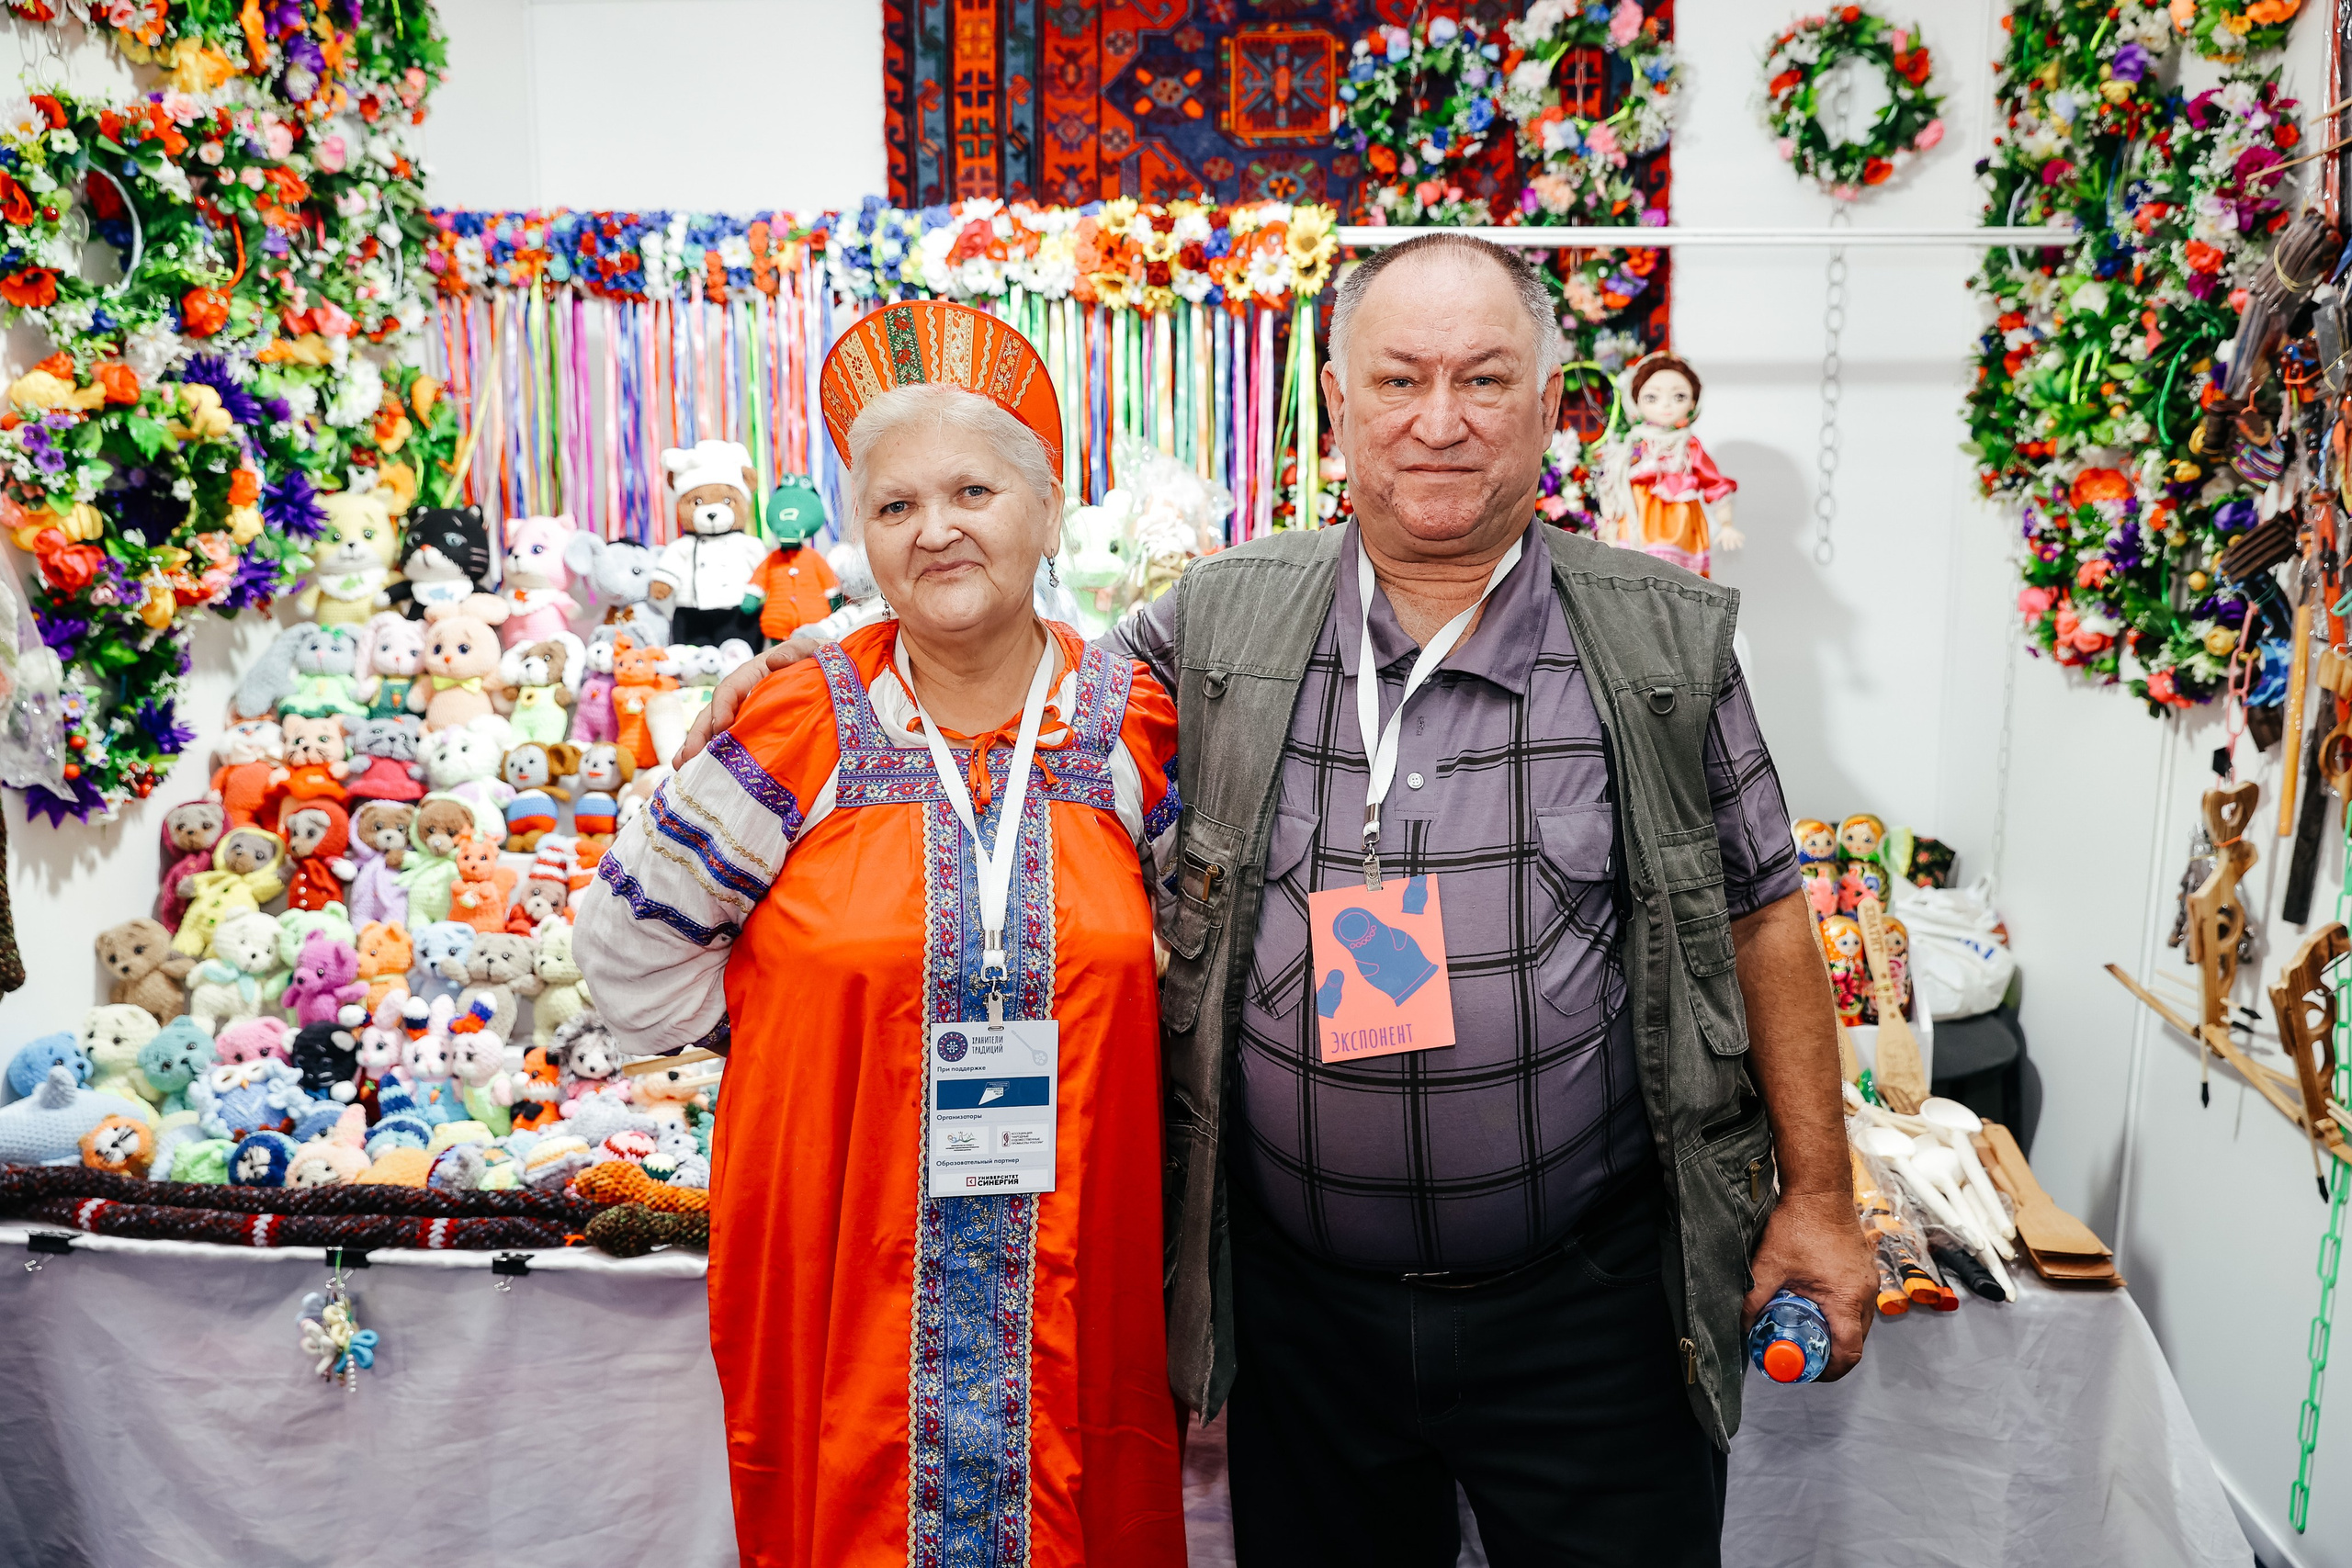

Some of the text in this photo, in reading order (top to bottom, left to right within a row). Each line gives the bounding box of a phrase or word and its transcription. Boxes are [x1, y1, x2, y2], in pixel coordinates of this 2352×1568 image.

[972, 1035, 1003, 1044] ХРАНИТЕЛИ
[1331, 1024, 1412, 1054] ЭКСПОНЕНТ
[972, 1044, 1003, 1055] ТРАДИЦИЙ
[936, 1158, 992, 1167] Образовательный
[978, 1179, 1019, 1187] СИНЕРГИЯ
